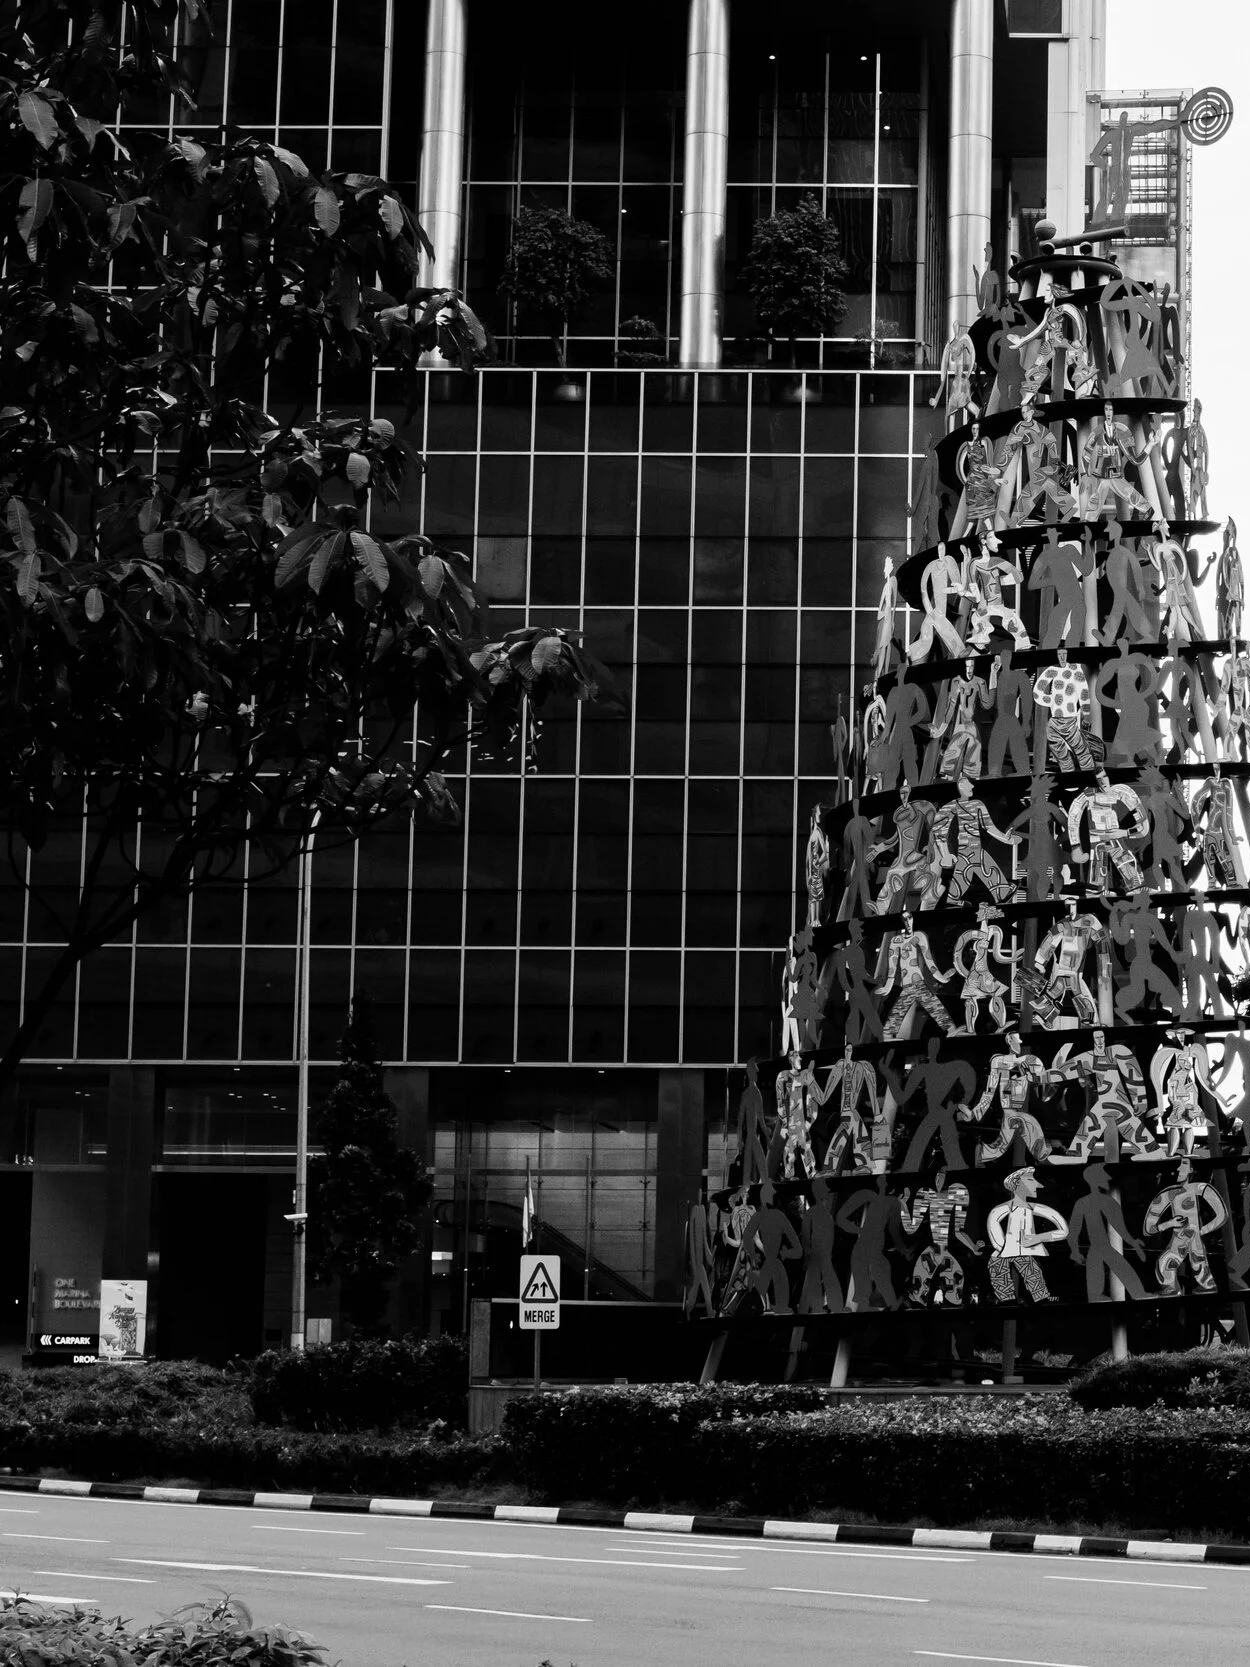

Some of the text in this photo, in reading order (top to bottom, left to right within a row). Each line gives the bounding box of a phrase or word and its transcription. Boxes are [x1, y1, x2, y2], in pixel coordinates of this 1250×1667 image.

[55, 1278, 75, 1288] ONE
[54, 1299, 101, 1309] BOULEVAR
[524, 1310, 556, 1323] MERGE
[54, 1336, 91, 1345] CARPARK
